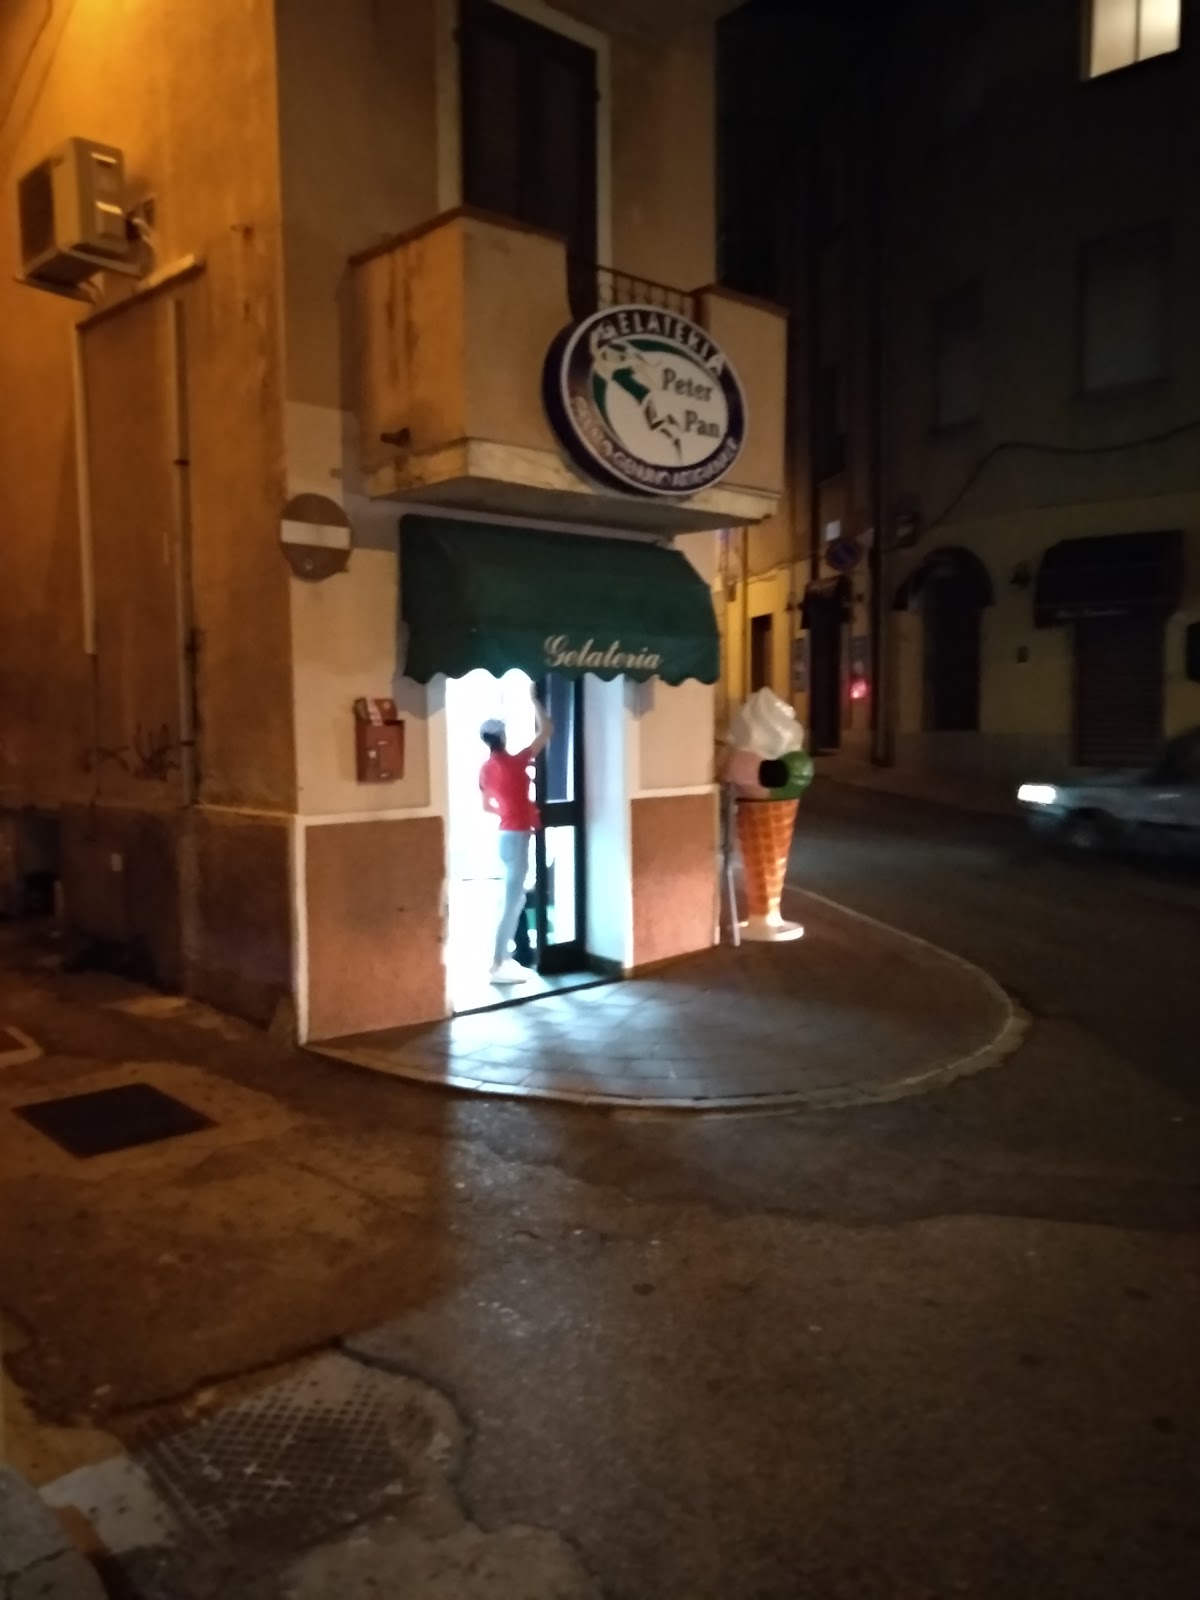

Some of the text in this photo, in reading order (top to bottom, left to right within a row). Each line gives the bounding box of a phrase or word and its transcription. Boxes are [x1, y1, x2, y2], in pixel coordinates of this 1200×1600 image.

[598, 311, 726, 376] GELATERIA
[662, 367, 714, 402] Peter
[684, 410, 720, 438] Pan
[543, 633, 662, 669] Gelateria
